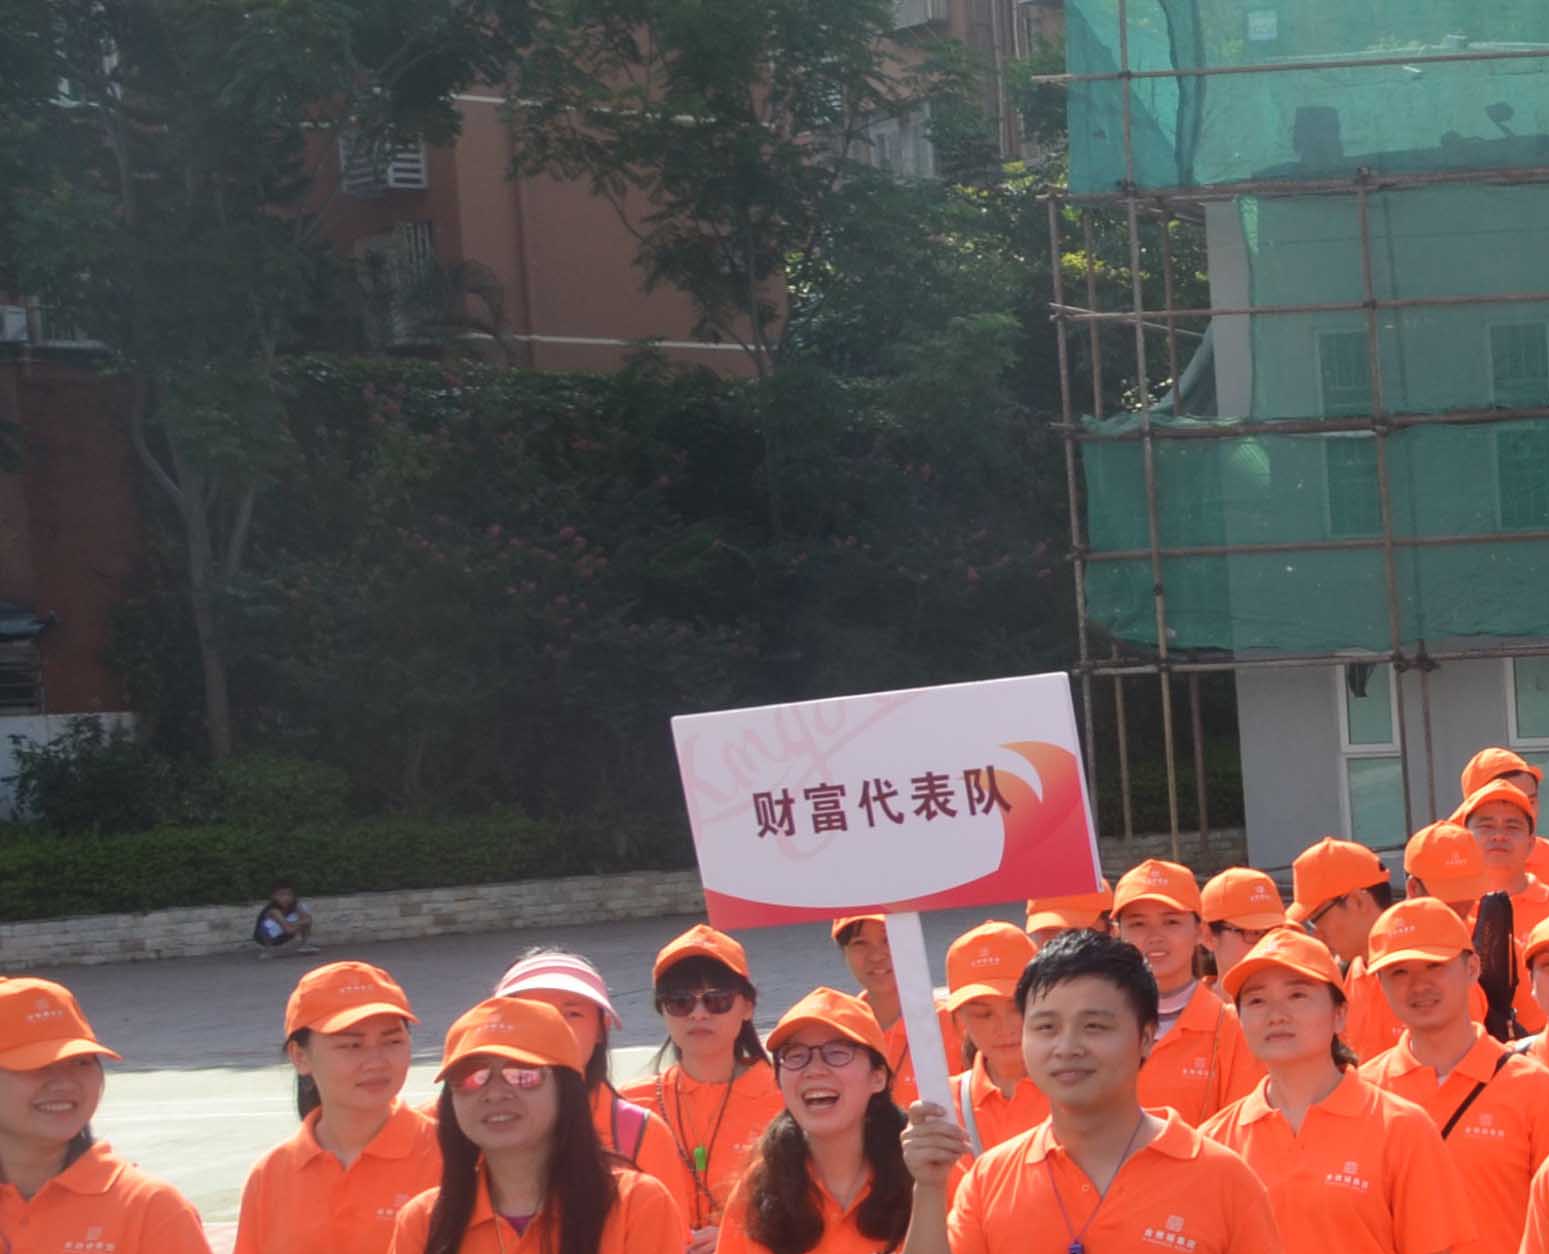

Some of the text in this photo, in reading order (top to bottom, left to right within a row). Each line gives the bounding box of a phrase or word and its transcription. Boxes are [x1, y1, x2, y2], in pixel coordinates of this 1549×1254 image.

[752, 765, 1012, 839] 财富代表队
